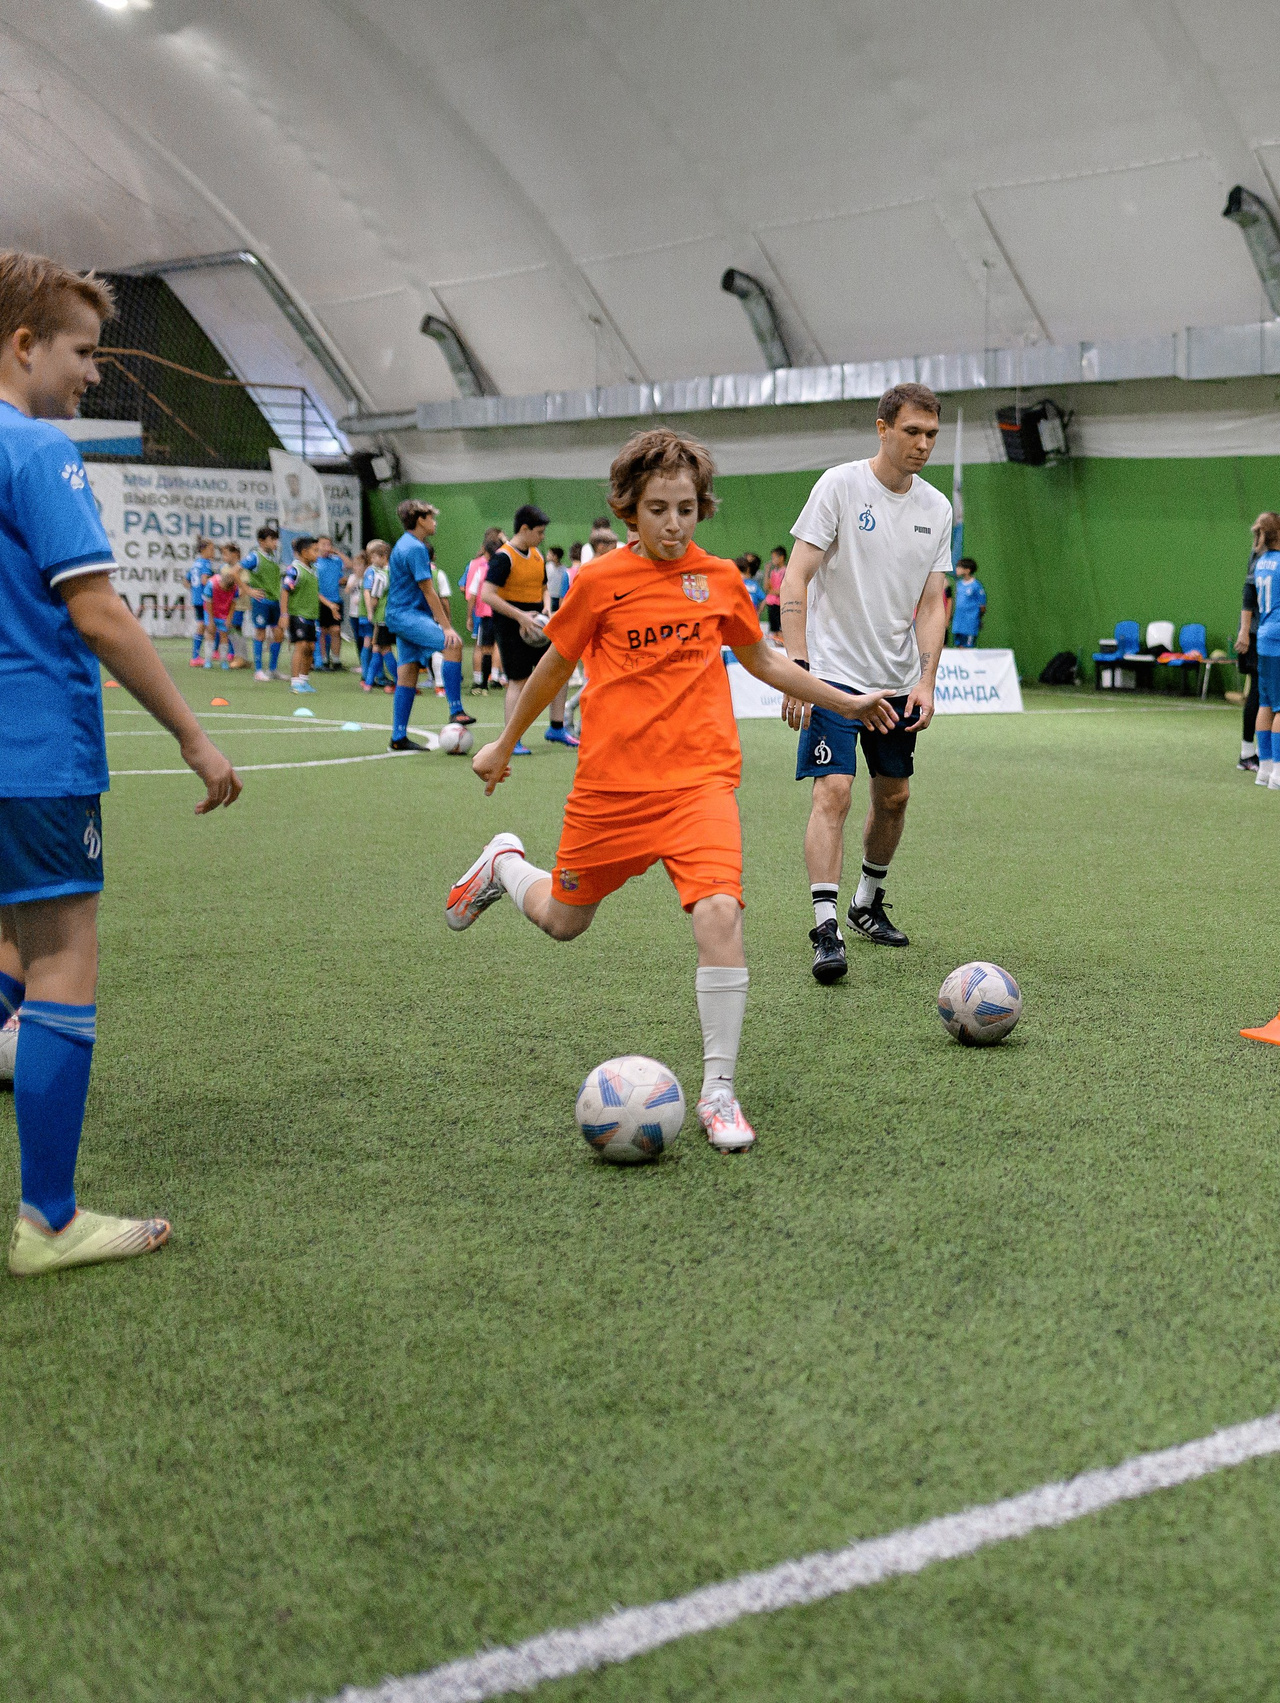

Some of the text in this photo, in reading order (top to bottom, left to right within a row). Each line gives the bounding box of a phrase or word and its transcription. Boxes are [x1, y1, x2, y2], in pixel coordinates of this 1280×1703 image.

[123, 510, 253, 539] РАЗНЫЕ
[914, 525, 932, 535] PUMA
[124, 541, 140, 559] С
[937, 664, 970, 681] ЗНЬ
[935, 685, 1001, 703] МАНДА
